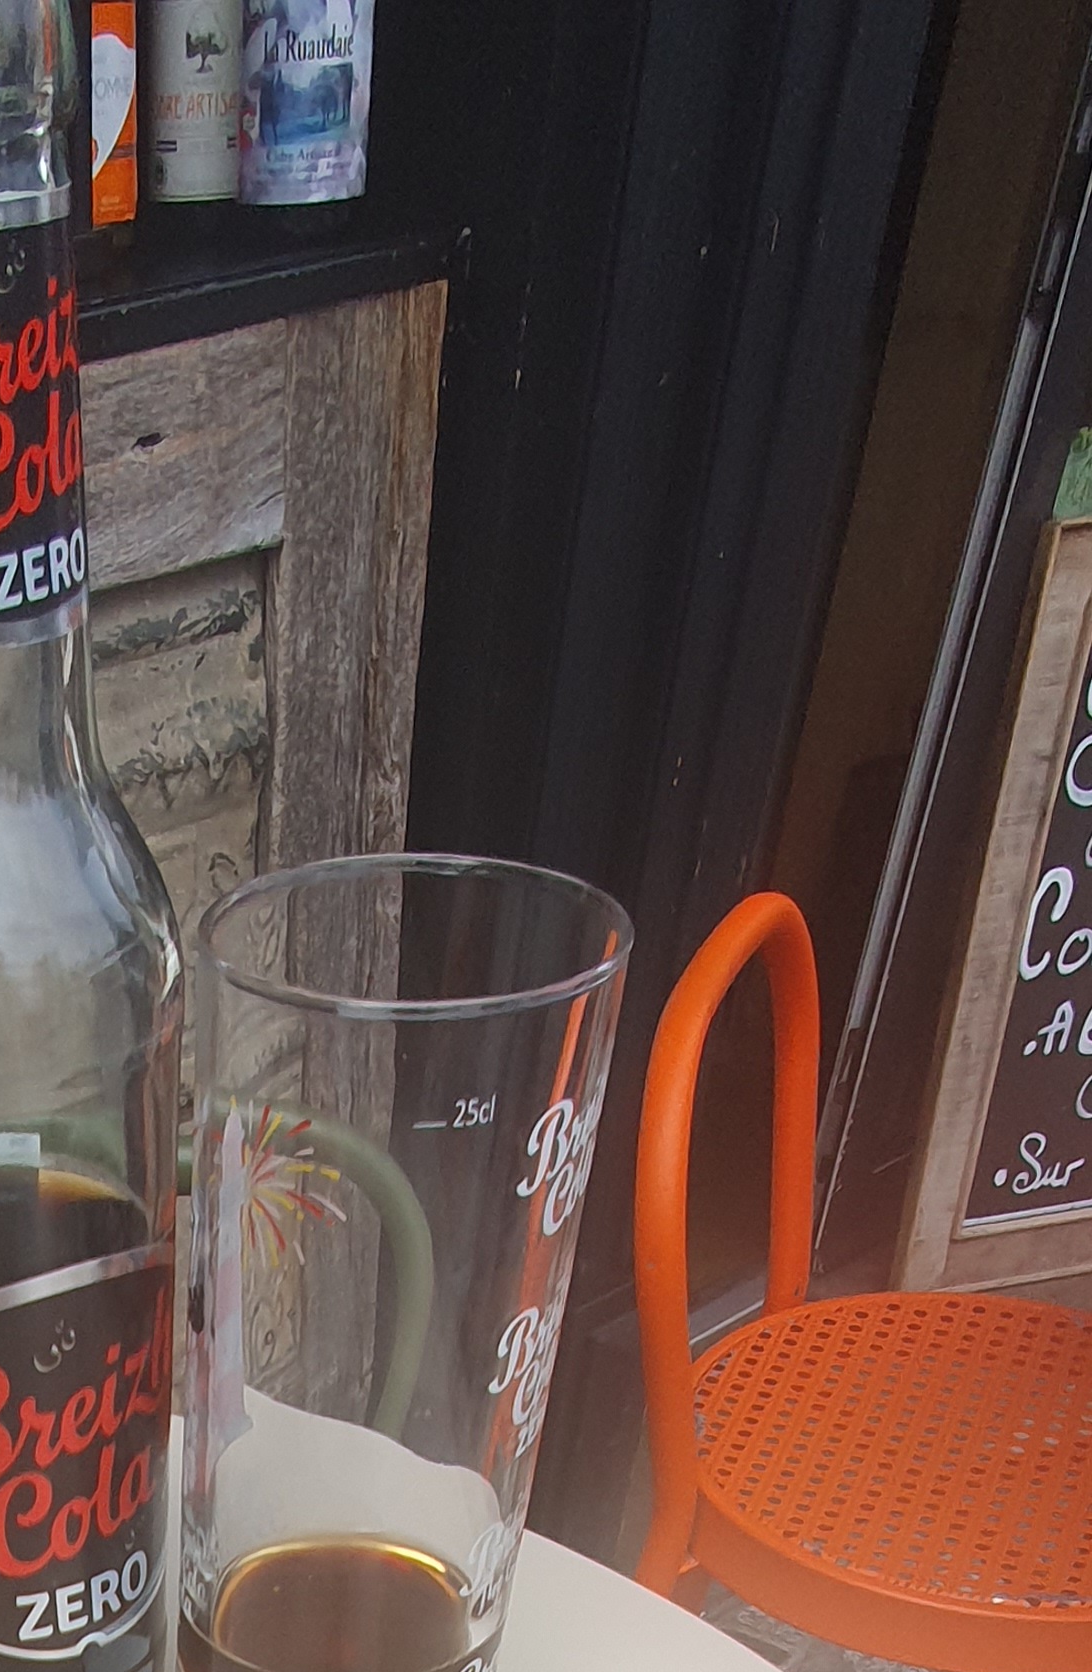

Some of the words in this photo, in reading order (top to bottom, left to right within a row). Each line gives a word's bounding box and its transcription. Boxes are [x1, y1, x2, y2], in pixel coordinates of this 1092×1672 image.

[286, 24, 355, 62] Ruaudaie
[452, 1094, 496, 1128] 25cl
[16, 1549, 148, 1643] ZERO
